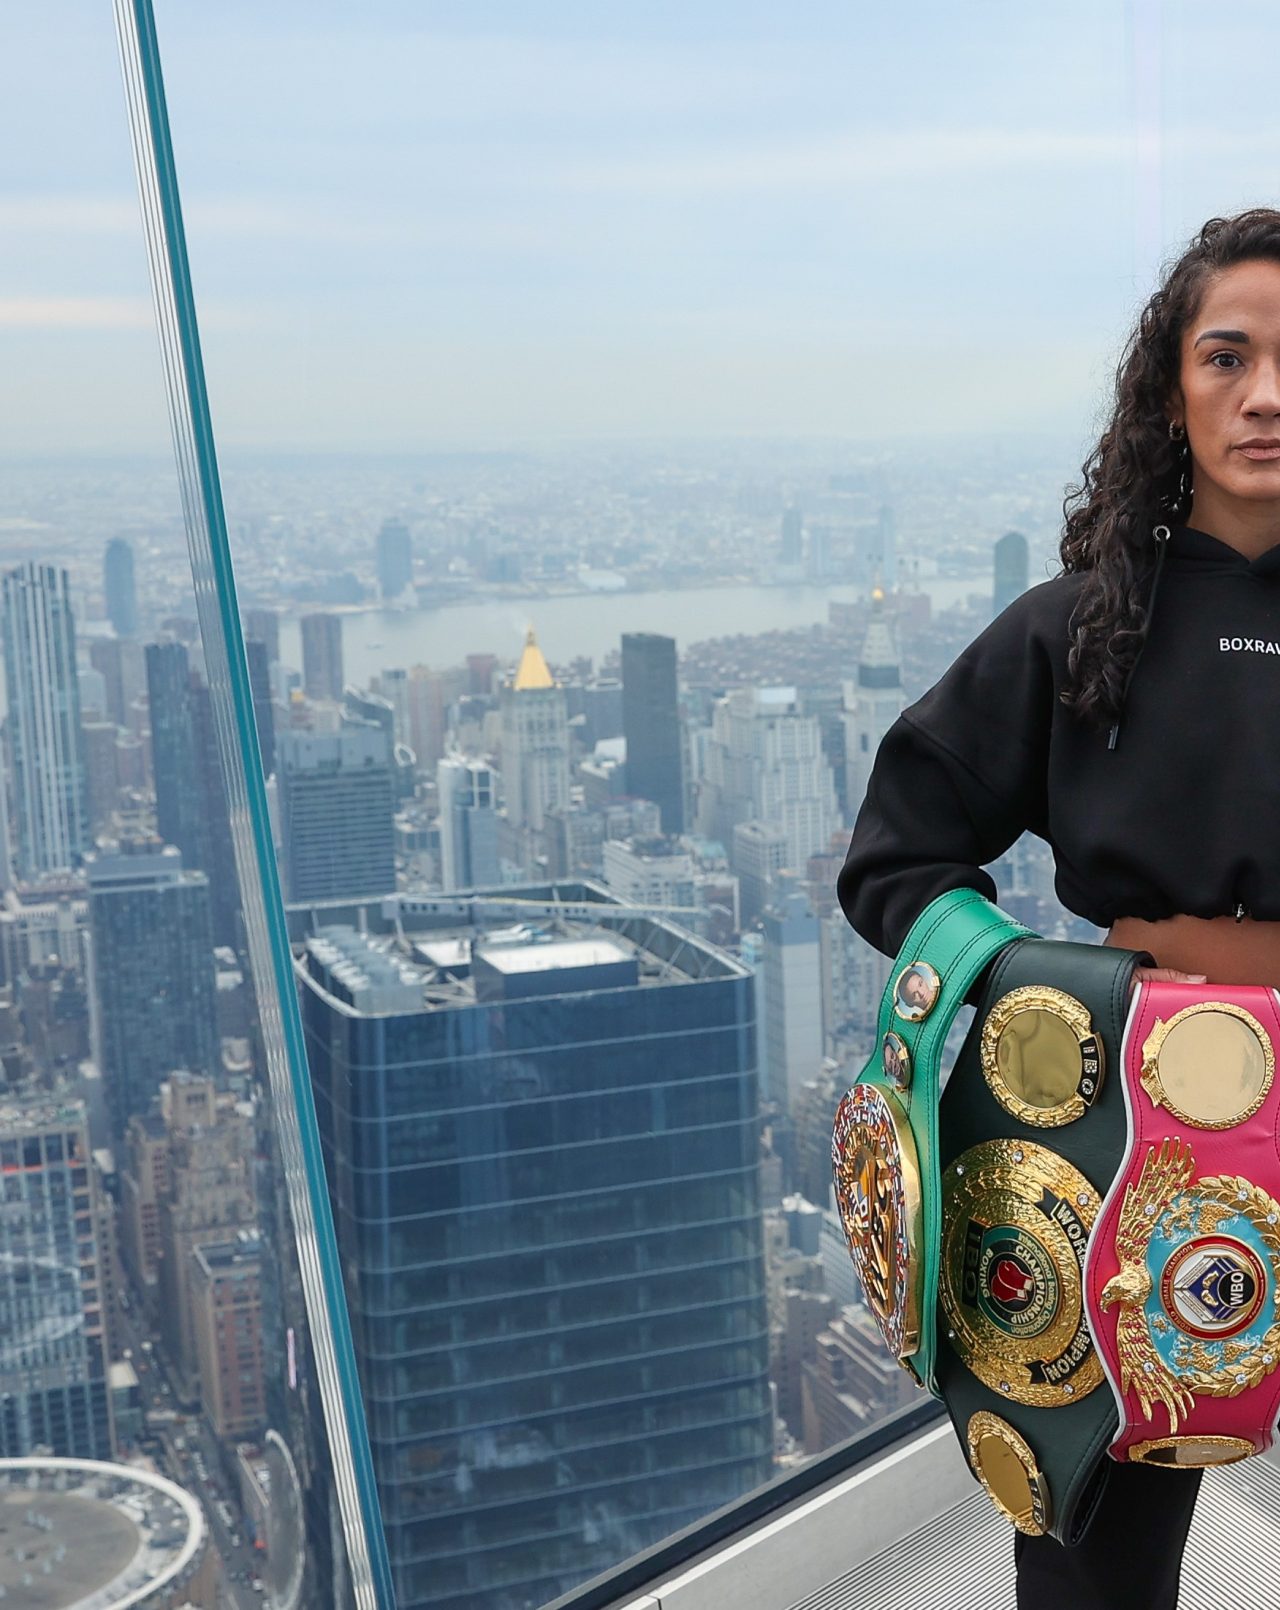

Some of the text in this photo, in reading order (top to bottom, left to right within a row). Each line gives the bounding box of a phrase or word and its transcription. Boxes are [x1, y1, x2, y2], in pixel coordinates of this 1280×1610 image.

[1081, 1045, 1098, 1095] IBO
[1017, 1230, 1055, 1280] International
[1165, 1244, 1194, 1276] CHAMPION
[979, 1244, 1046, 1325] BOXING CHAMPIONSHIP
[1229, 1271, 1245, 1306] WBO
